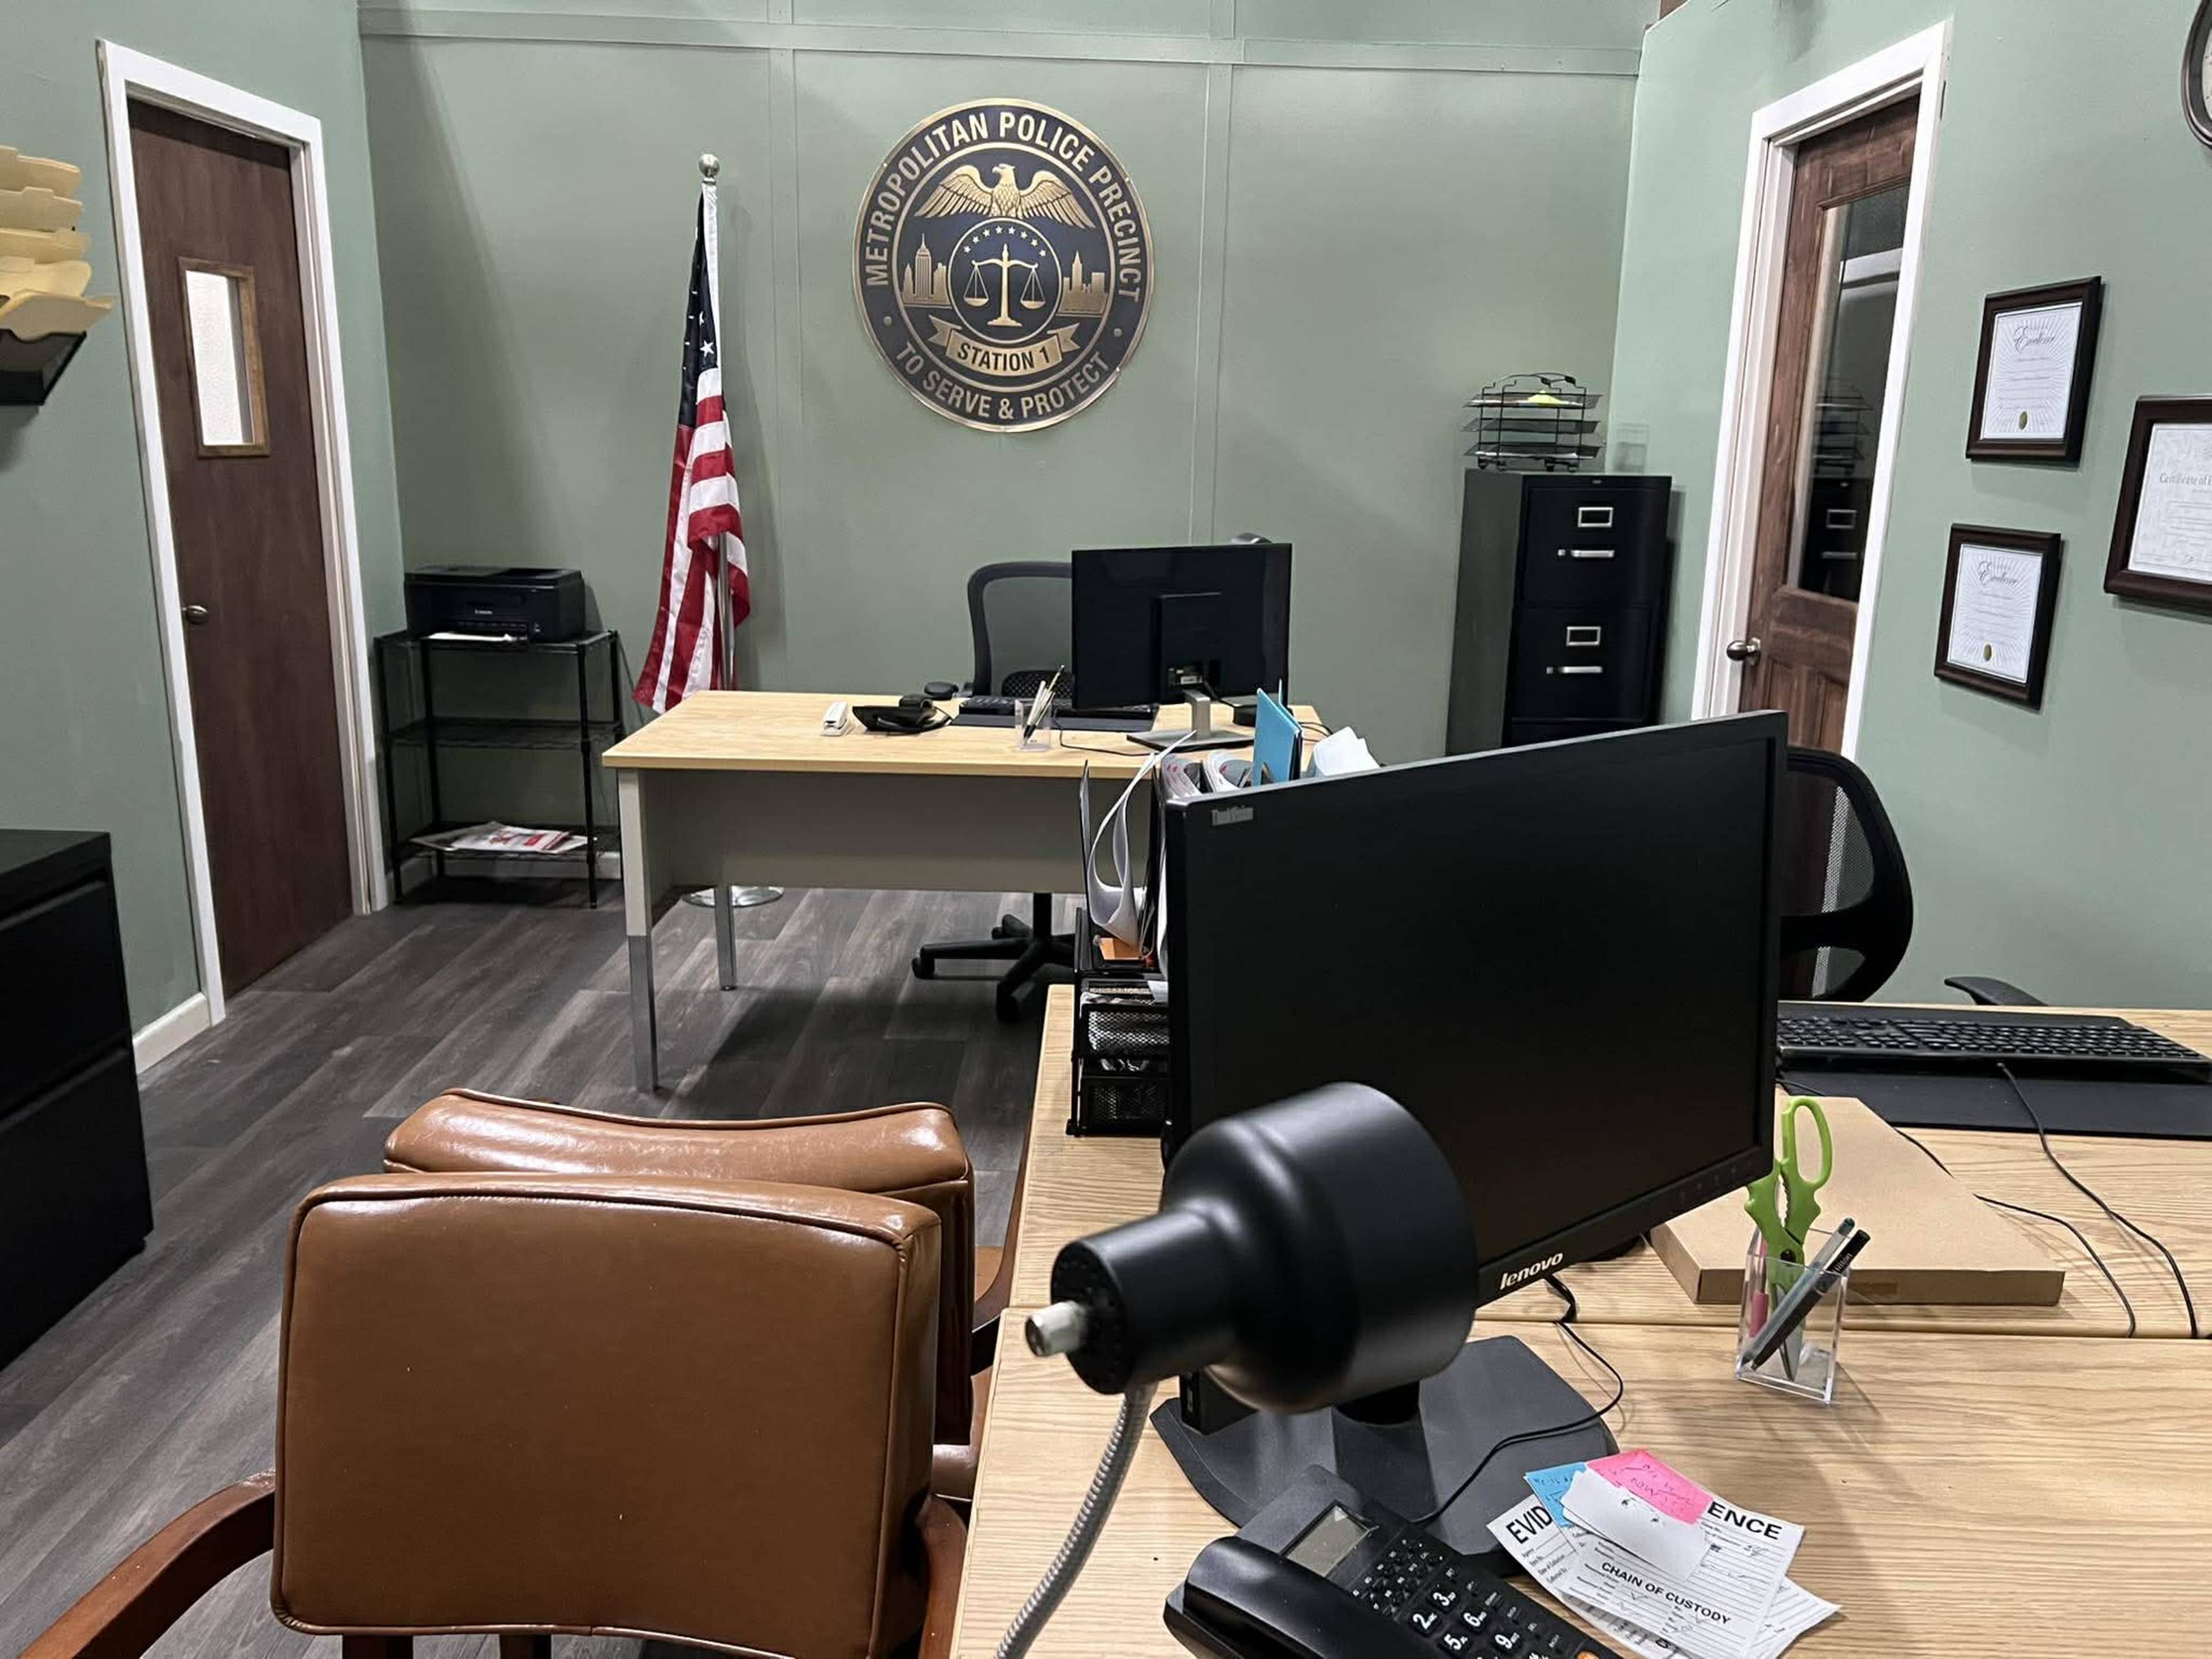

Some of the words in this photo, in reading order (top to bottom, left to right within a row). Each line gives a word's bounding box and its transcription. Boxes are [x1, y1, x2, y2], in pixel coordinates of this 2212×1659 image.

[866, 113, 988, 286] METROPOLITAN
[1000, 112, 1094, 172] POLICE
[1089, 166, 1141, 303] PRECINCT
[957, 343, 1035, 371] STATION
[1040, 343, 1051, 363] 1
[896, 341, 925, 377] TO
[922, 370, 993, 418] SERVE
[998, 397, 1014, 419] &
[1022, 352, 1111, 417] PROTECT
[1499, 1252, 1563, 1290] lenovo
[1433, 1592, 1450, 1606] 3
[1601, 1562, 1643, 1587] CHAIN
[1644, 1582, 1665, 1594] OF
[1665, 1592, 1732, 1626] CUSTODY
[1412, 1613, 1431, 1630] 2
[1463, 1613, 1481, 1627] 6
[1444, 1634, 1462, 1650] 5
[1495, 1634, 1513, 1649] 9
